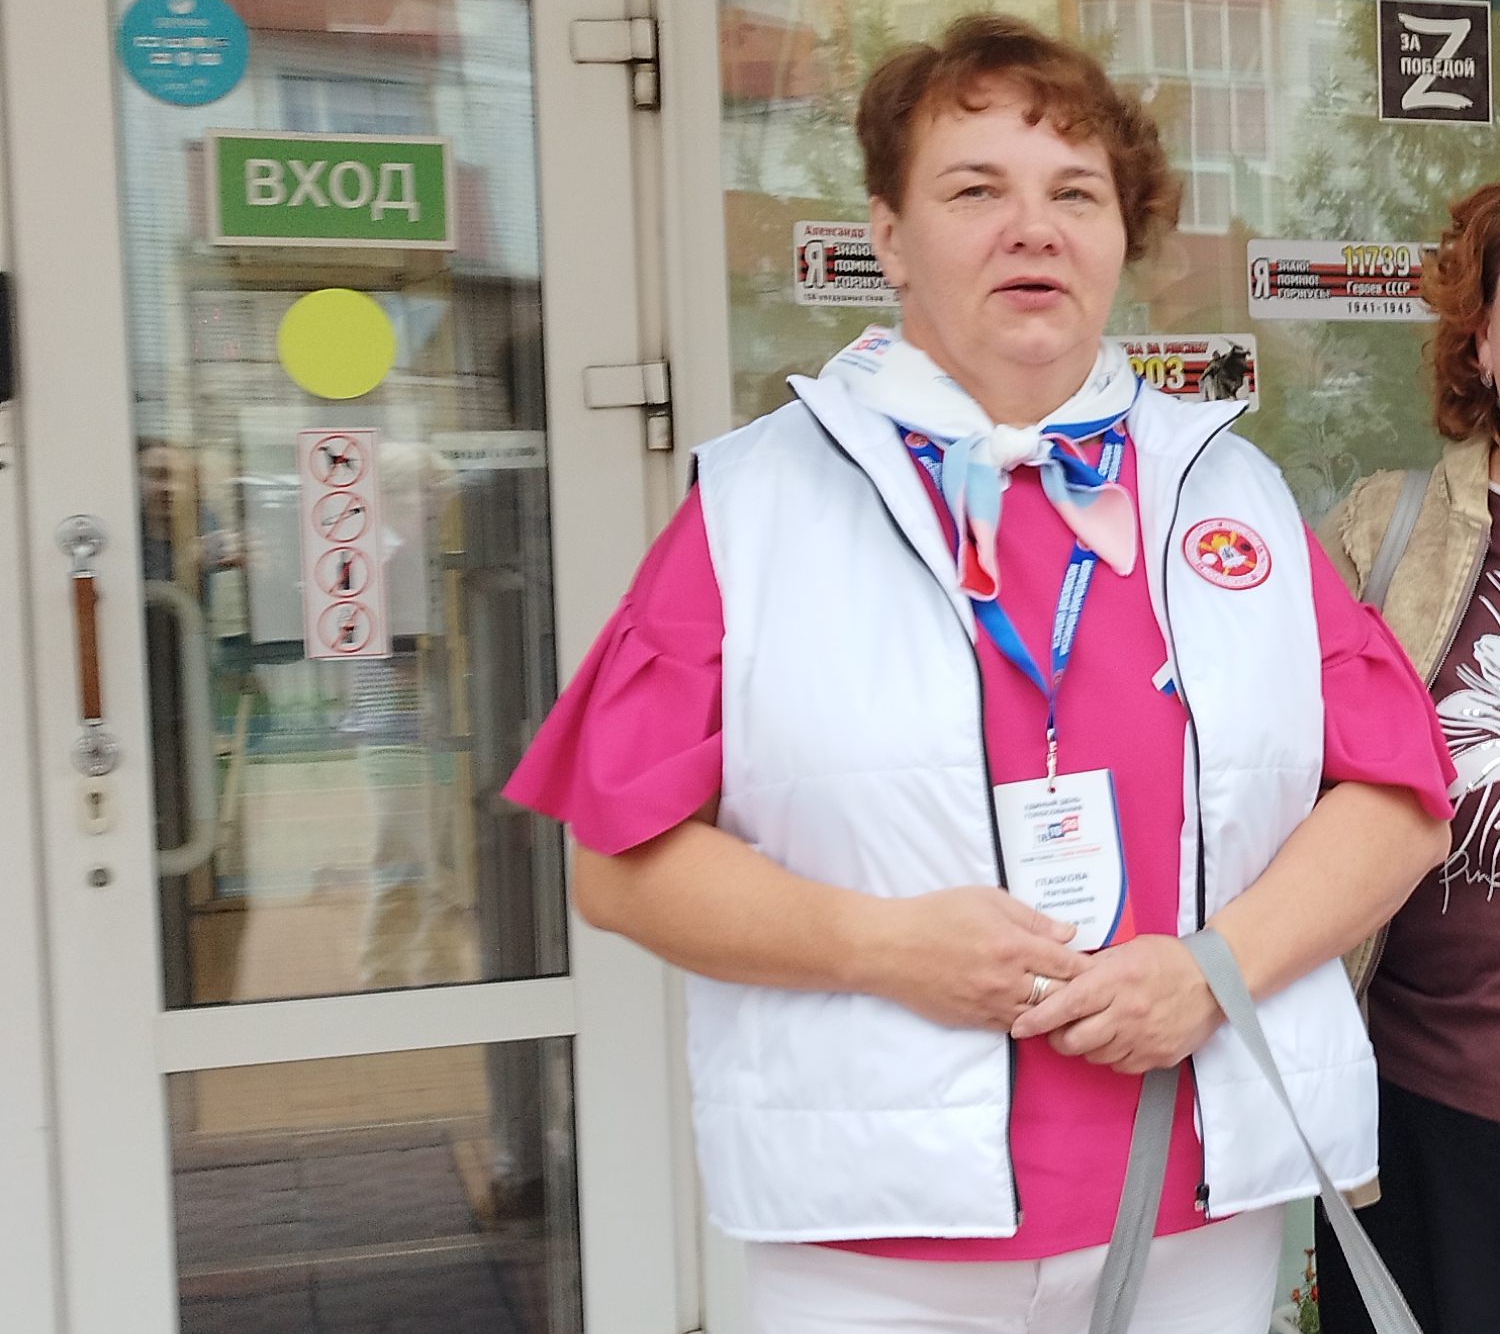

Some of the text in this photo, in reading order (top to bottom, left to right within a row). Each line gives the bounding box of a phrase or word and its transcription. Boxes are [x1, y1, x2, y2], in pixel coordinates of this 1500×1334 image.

[1400, 33, 1421, 52] ЗА
[1400, 56, 1475, 80] ПОБЕДОЙ
[244, 158, 421, 222] ВХОД
[833, 242, 875, 256] ЗНАЮ
[1341, 244, 1411, 278] 11739
[804, 239, 825, 289] Я
[1252, 257, 1270, 299] Я
[1385, 279, 1411, 297] СССР
